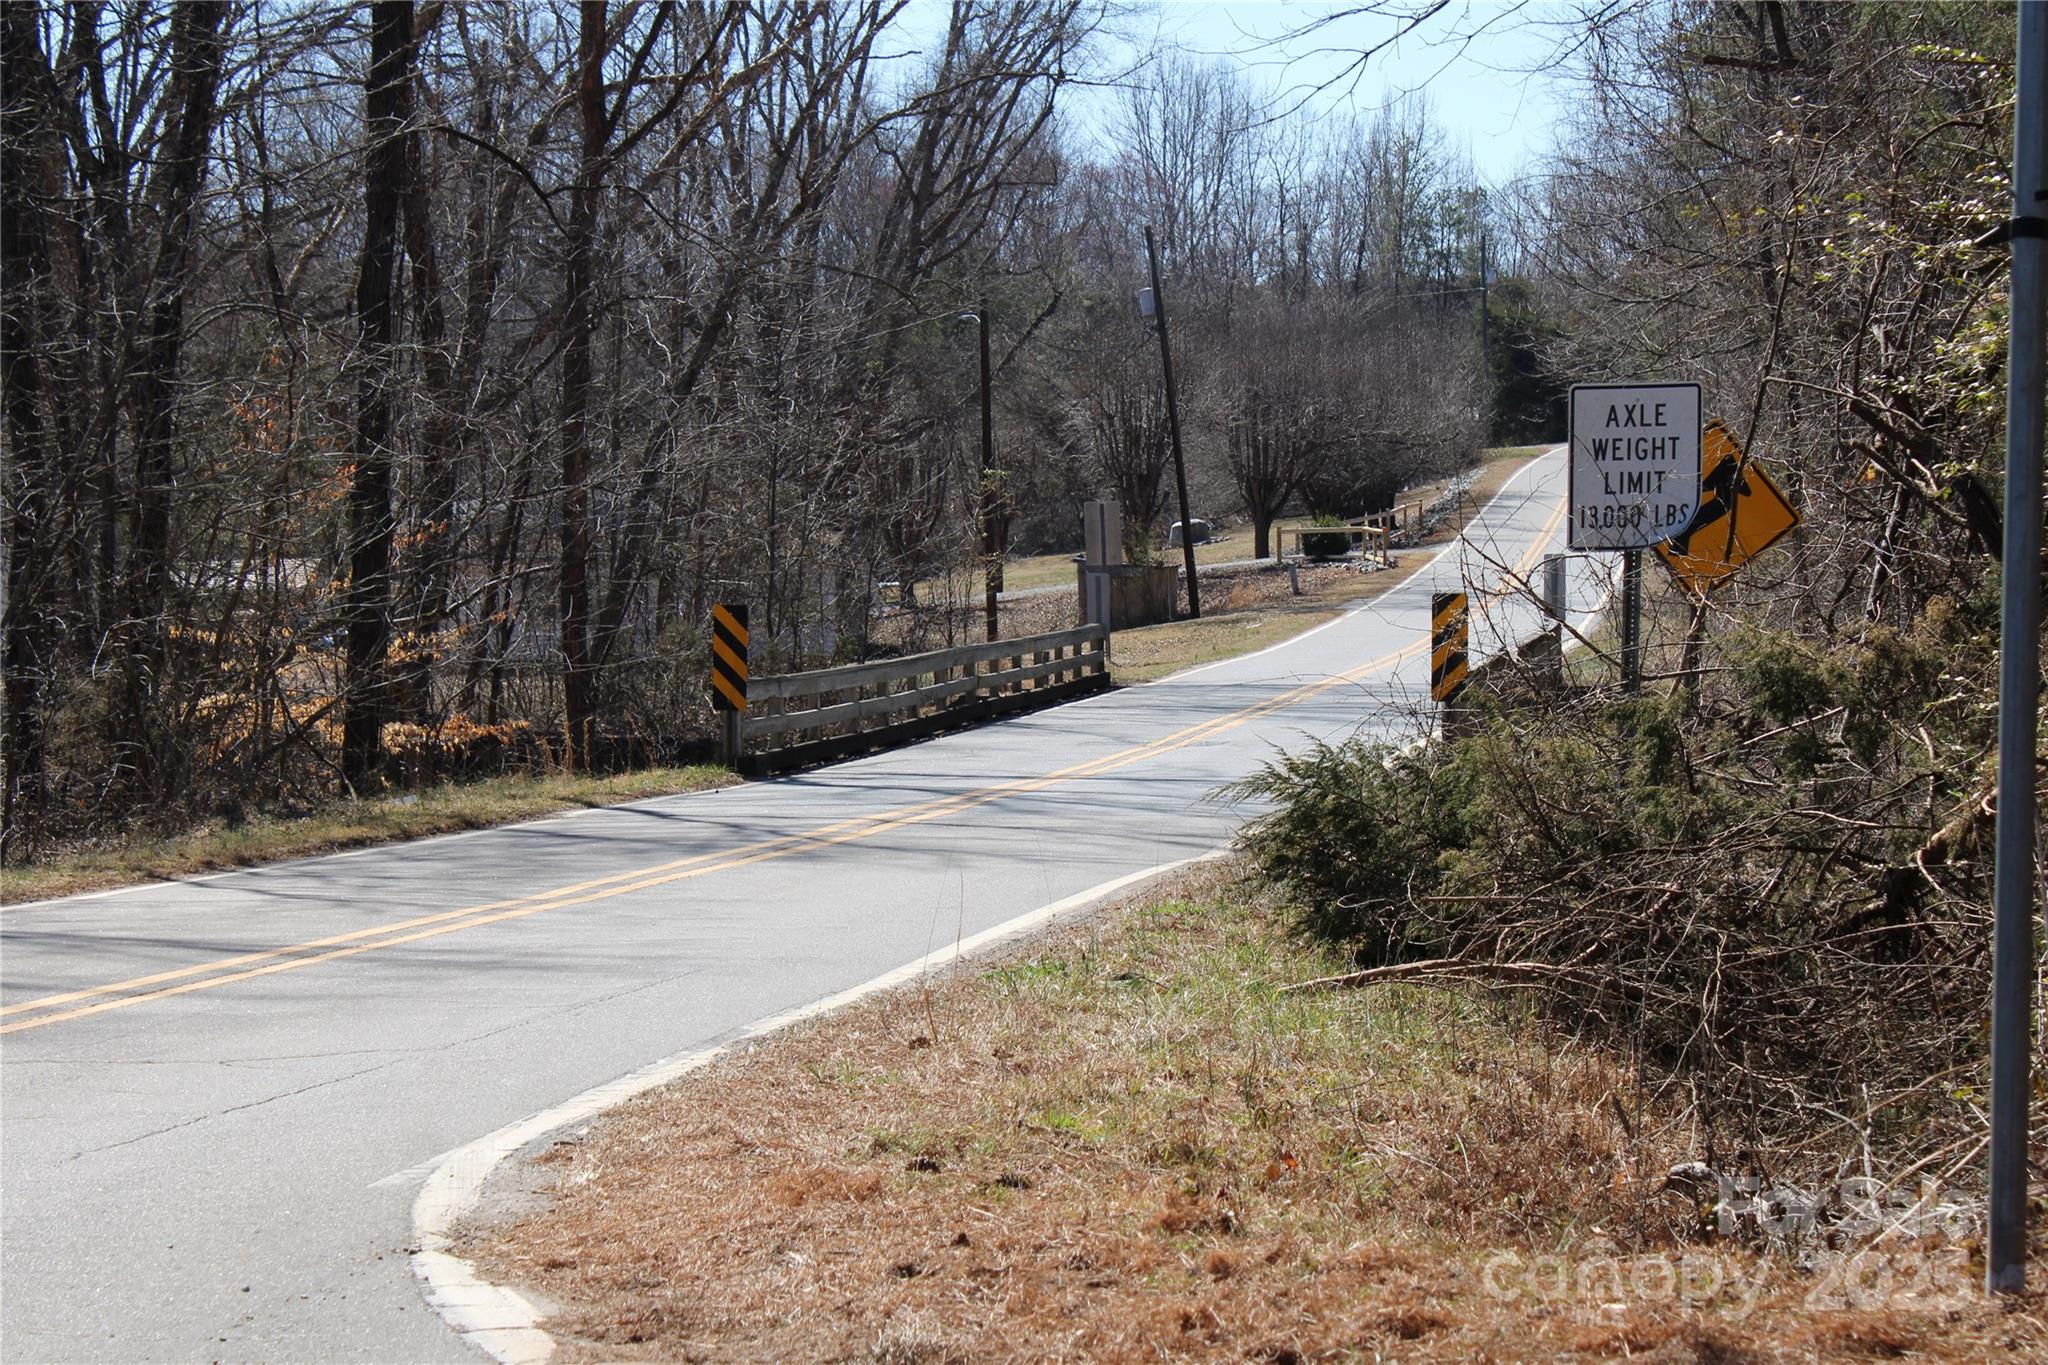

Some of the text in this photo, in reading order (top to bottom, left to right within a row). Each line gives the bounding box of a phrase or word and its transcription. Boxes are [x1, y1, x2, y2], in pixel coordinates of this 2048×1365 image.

[1605, 403, 1667, 428] AXLE
[1592, 437, 1680, 461] WEIGHT
[1604, 471, 1667, 495] LIMIT
[1655, 503, 1689, 528] LBS
